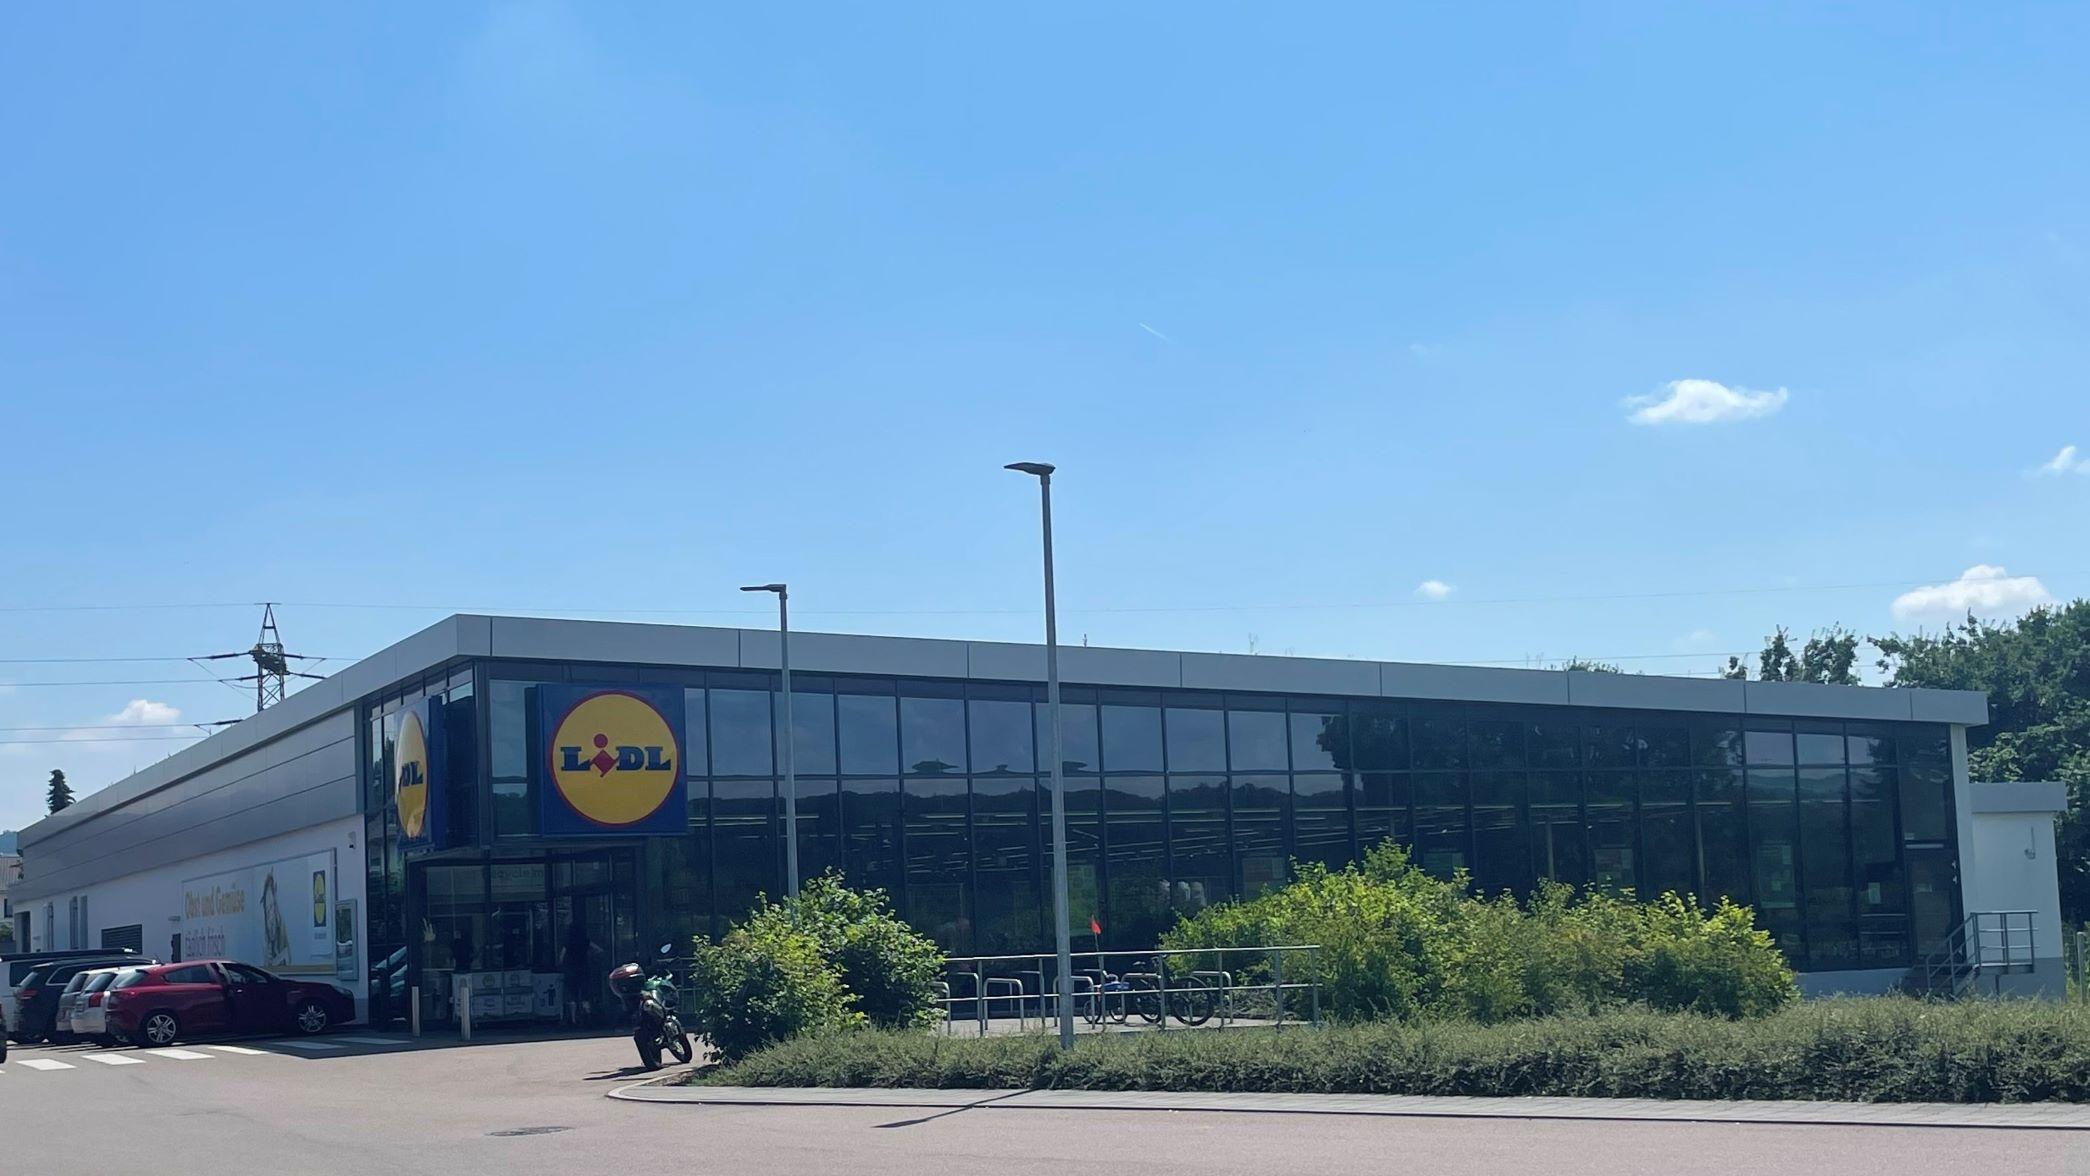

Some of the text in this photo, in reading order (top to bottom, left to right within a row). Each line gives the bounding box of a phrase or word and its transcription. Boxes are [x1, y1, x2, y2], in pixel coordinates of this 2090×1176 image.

[185, 883, 245, 920] Obst und Gemüse
